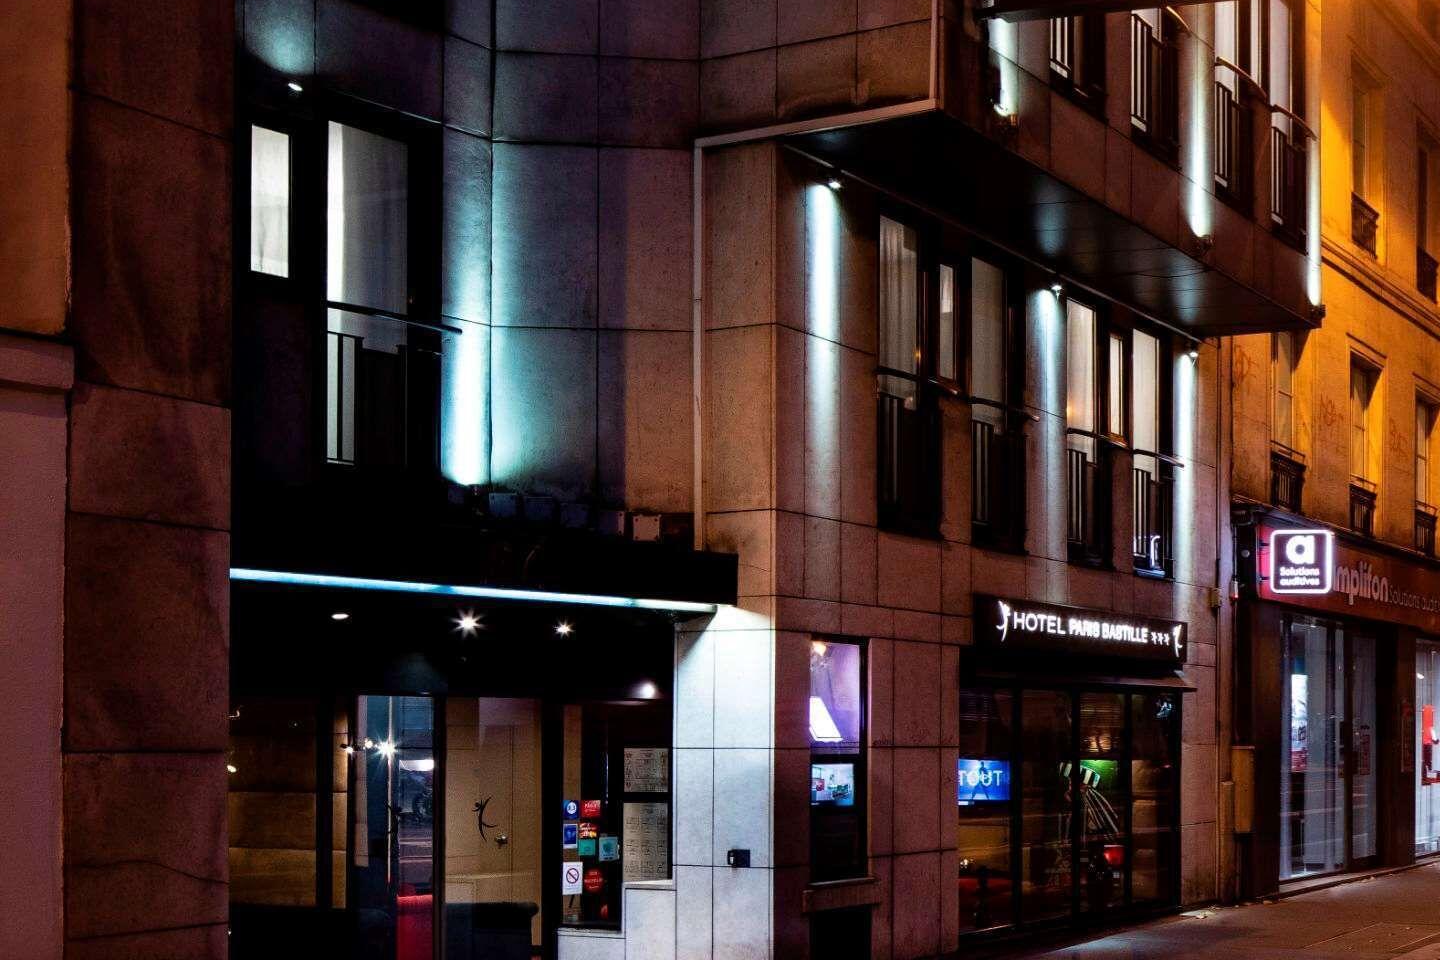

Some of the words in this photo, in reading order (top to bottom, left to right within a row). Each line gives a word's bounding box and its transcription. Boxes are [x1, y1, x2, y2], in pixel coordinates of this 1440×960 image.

[1279, 566, 1320, 576] Solutions
[1279, 576, 1320, 587] auditives
[1332, 561, 1389, 605] mplifon
[1013, 611, 1066, 634] HOTEL
[1068, 618, 1100, 638] PARIS
[1101, 622, 1148, 643] BASTILLE
[958, 769, 1003, 787] TOUT
